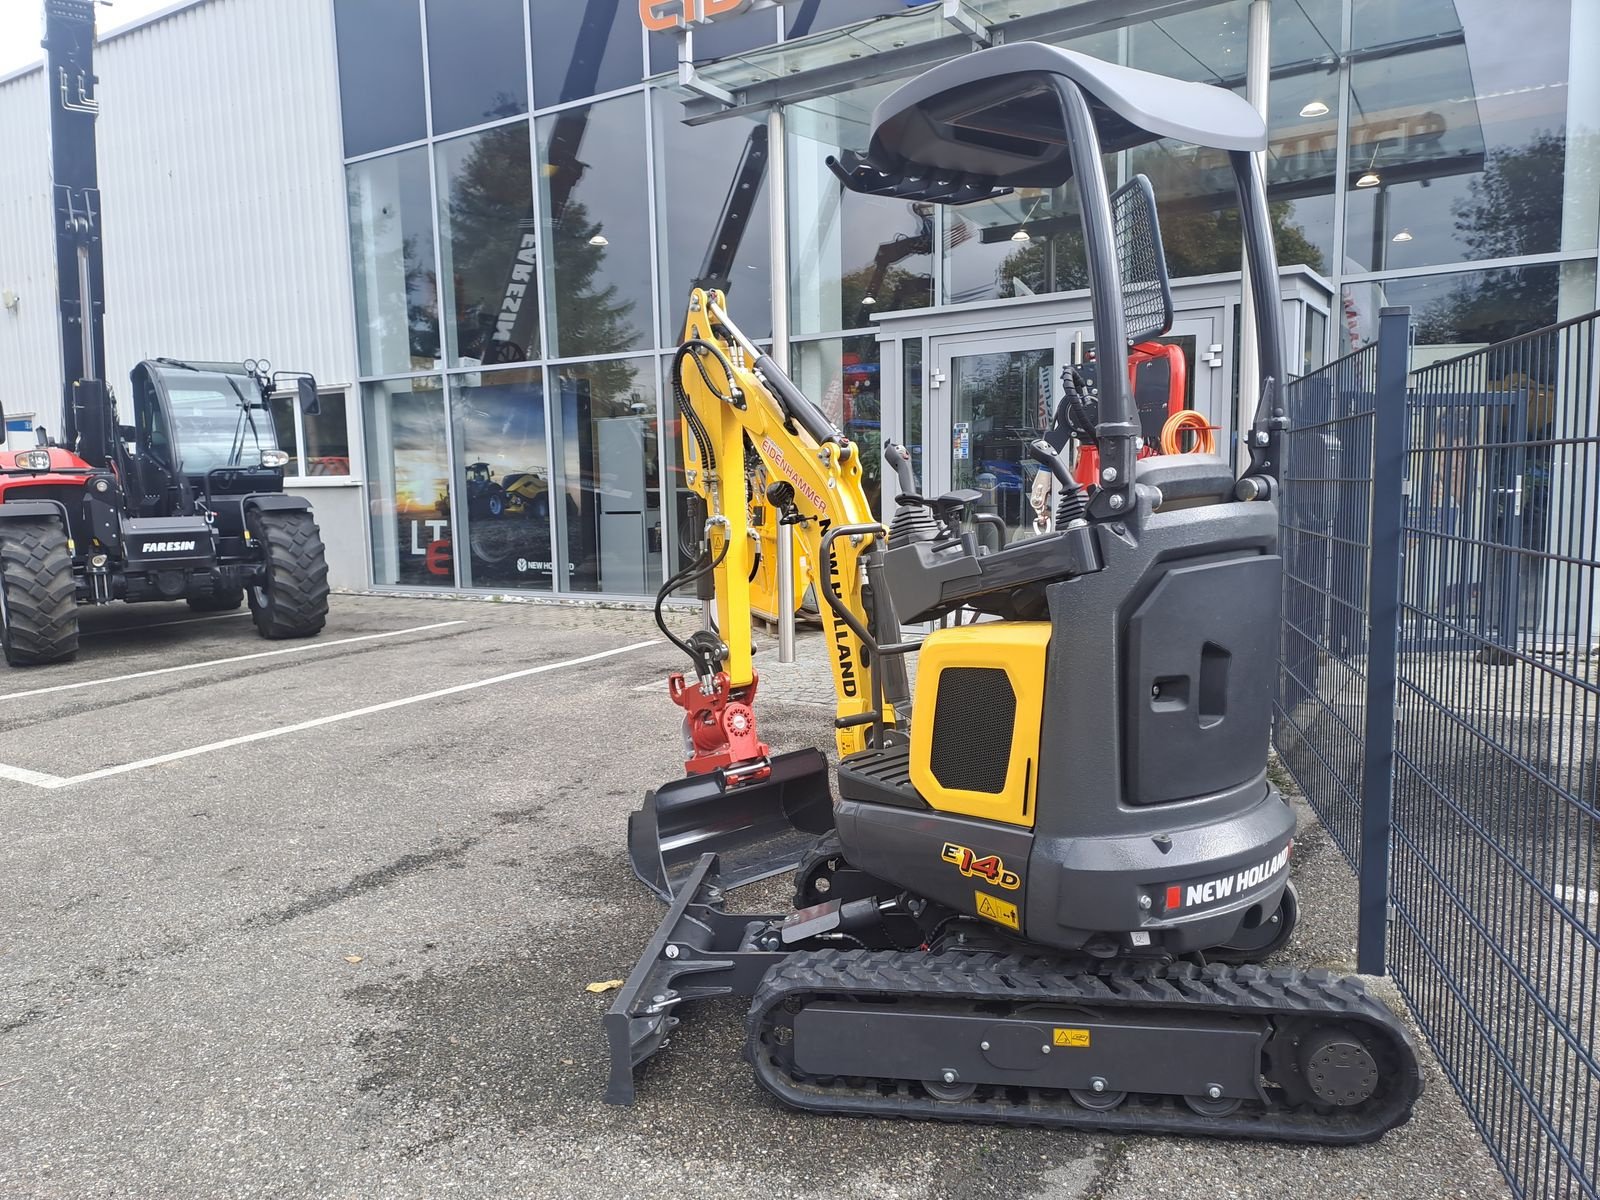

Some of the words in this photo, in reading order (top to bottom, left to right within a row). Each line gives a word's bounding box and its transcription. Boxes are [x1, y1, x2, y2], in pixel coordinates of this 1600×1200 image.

[761, 439, 827, 513] EIDENHAMMER
[142, 540, 196, 553] FARESIN
[527, 561, 543, 570] NEW
[830, 582, 857, 698] HLLAND
[1185, 875, 1235, 907] NEW
[1236, 845, 1289, 893] HOLLAND
